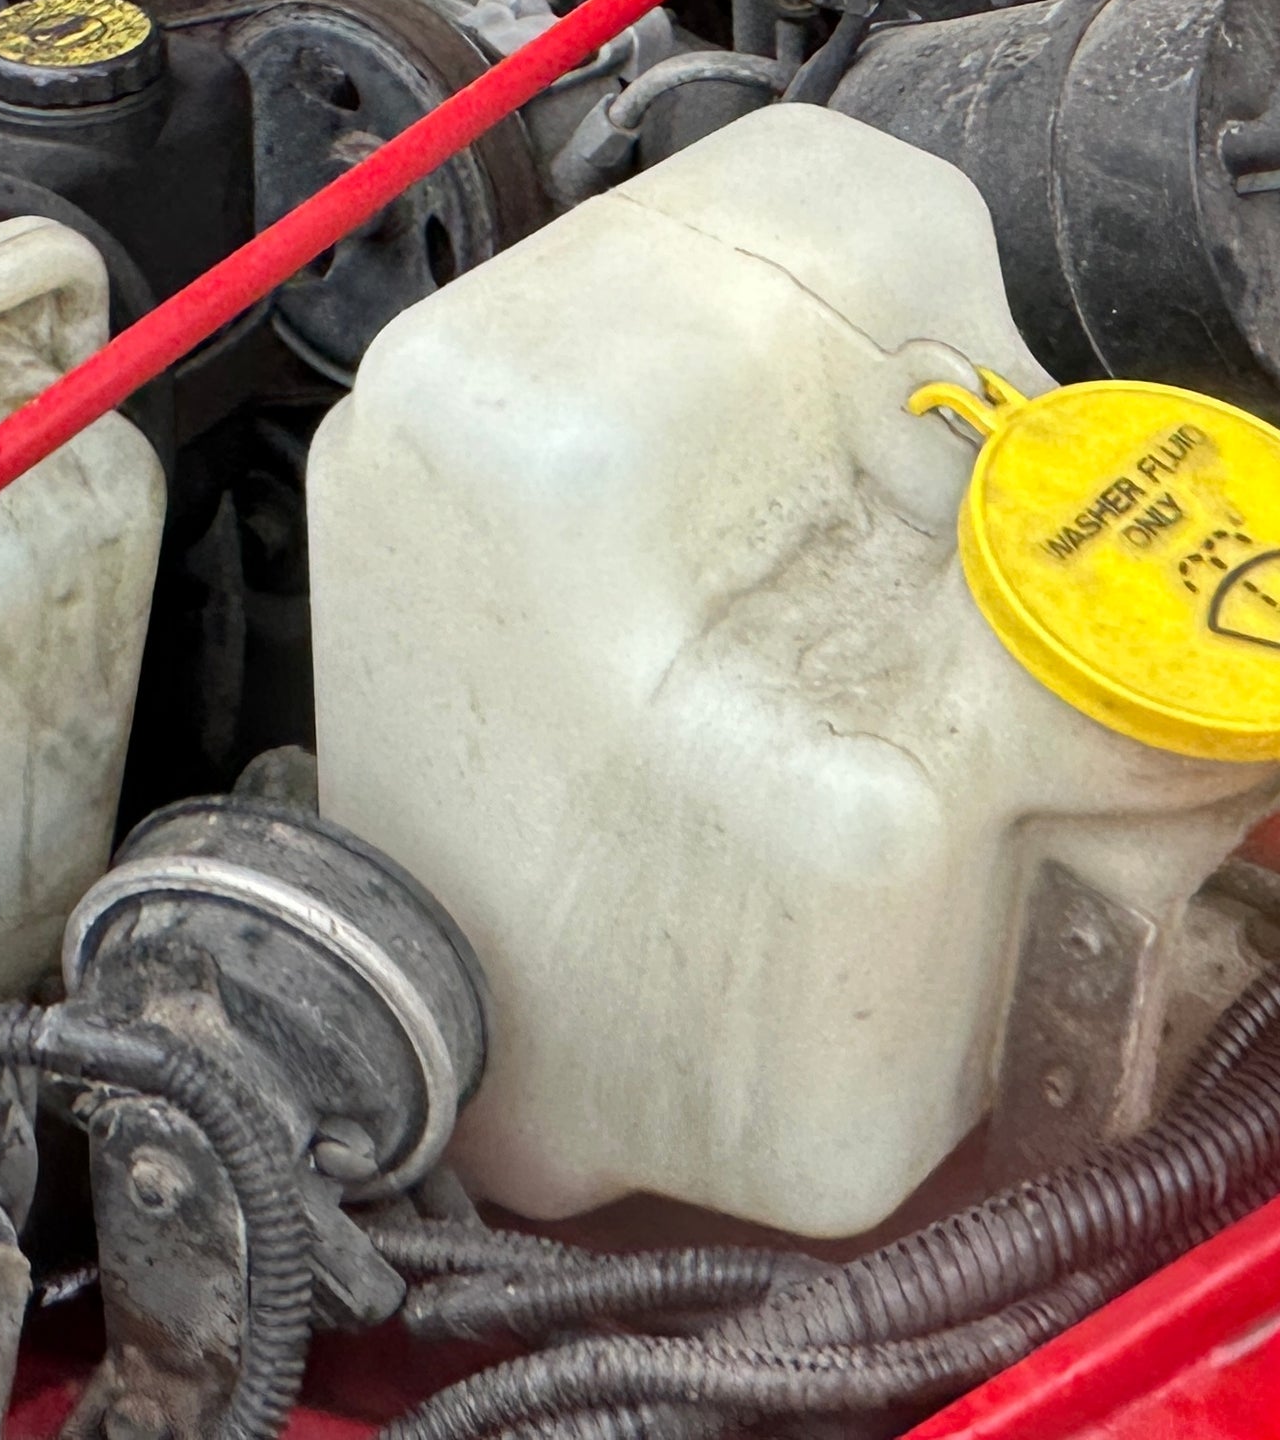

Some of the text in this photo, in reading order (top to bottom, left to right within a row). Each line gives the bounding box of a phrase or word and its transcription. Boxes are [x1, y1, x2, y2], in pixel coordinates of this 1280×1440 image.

[1039, 423, 1210, 561] WASHER FLUID
[1119, 491, 1187, 550] ONLY
